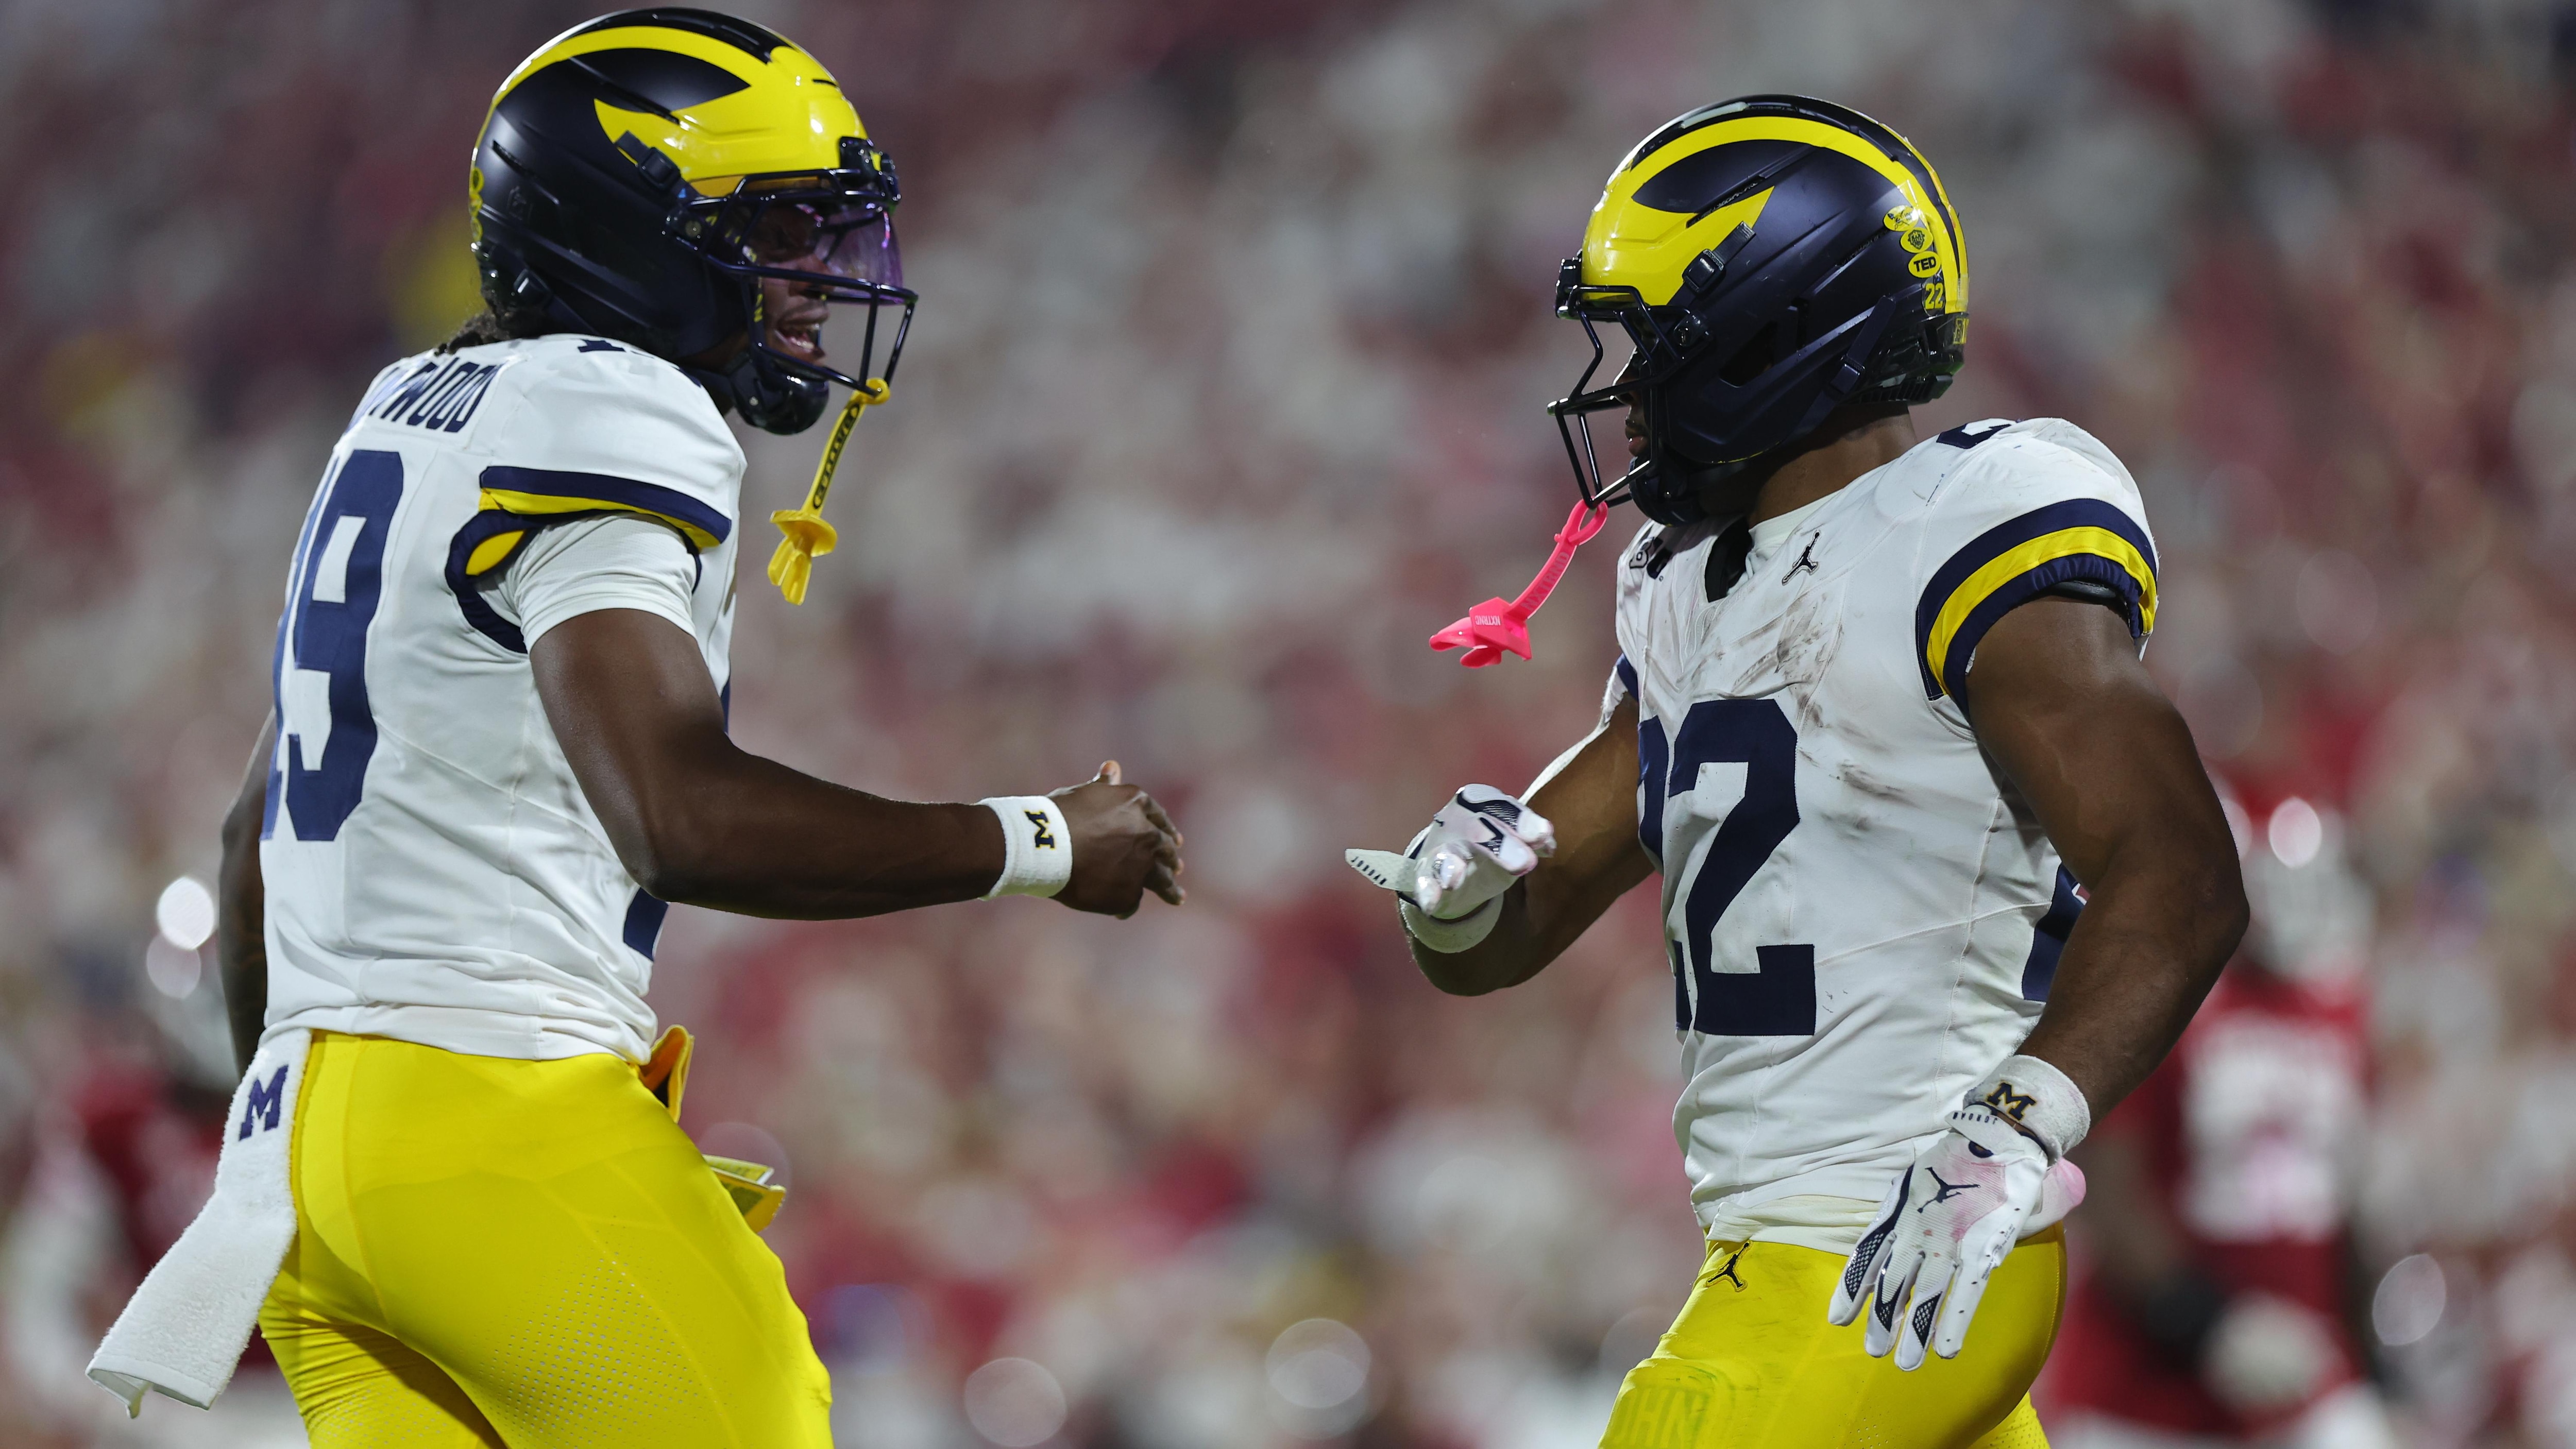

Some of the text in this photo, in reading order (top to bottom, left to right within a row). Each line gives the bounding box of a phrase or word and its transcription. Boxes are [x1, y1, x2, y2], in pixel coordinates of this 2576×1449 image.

[1913, 256, 1937, 272] TED
[1925, 283, 1943, 310] 22
[239, 1064, 289, 1141] M
[1986, 1081, 2037, 1121] M
